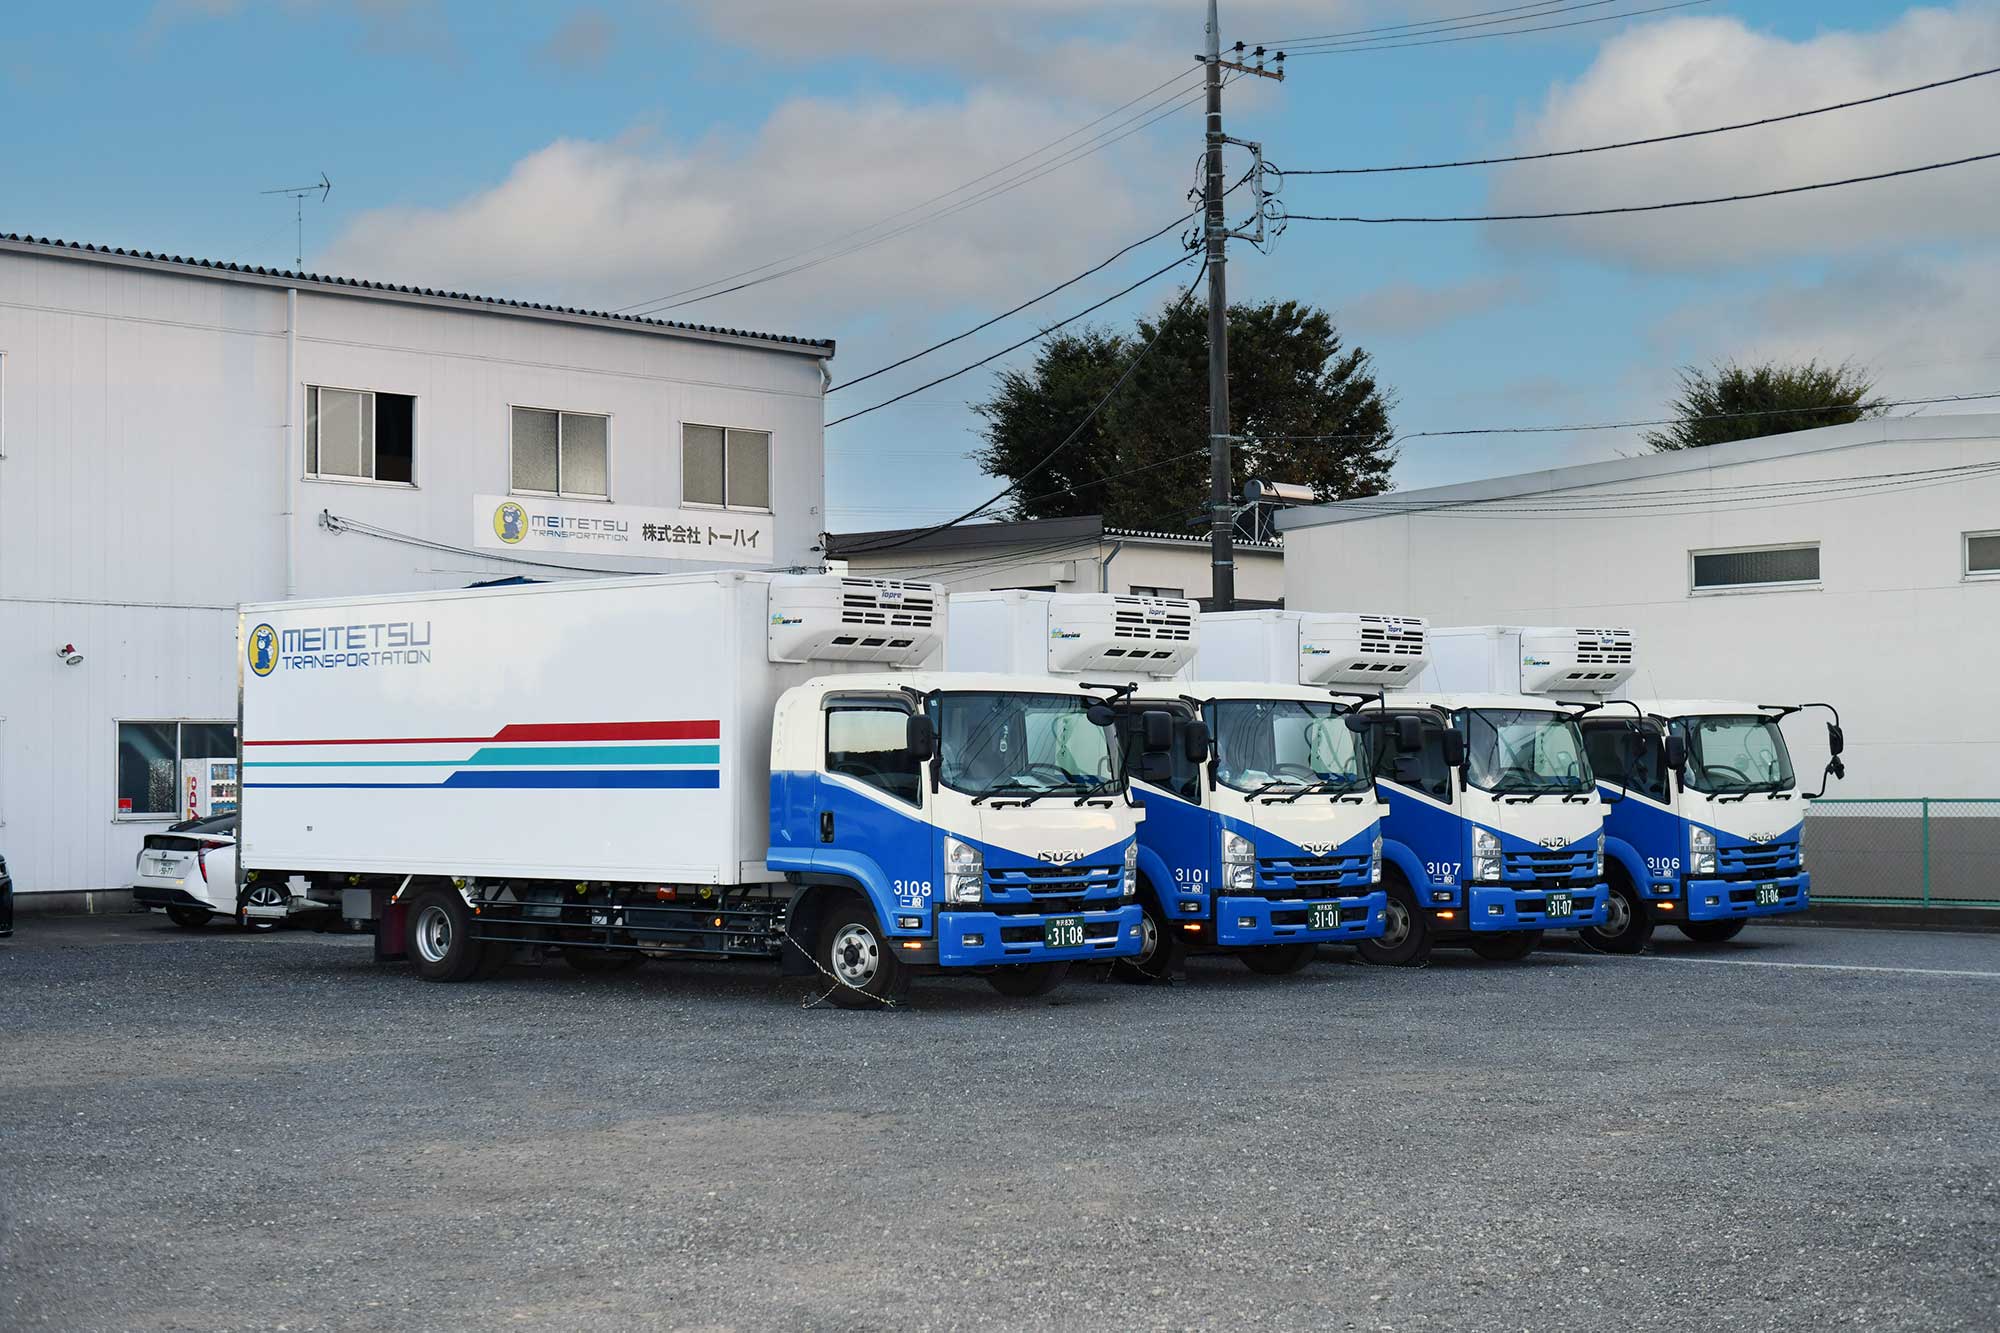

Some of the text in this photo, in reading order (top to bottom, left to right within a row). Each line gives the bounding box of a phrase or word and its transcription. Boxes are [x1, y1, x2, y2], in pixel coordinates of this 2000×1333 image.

[531, 514, 629, 533] MEITETSU
[531, 529, 629, 542] TRANSPORTATION
[641, 523, 760, 548] 株式会社 トーハイ
[282, 621, 431, 653] MEITETSU
[282, 649, 431, 670] TRANSPORTATION
[1300, 842, 1339, 853] ISUZU
[1538, 837, 1571, 848] ISUZU
[1037, 849, 1084, 862] ISUZU
[1426, 862, 1461, 876] 3107
[1647, 857, 1680, 870] 3106
[1175, 867, 1209, 883] 3101
[893, 879, 932, 896] 3108
